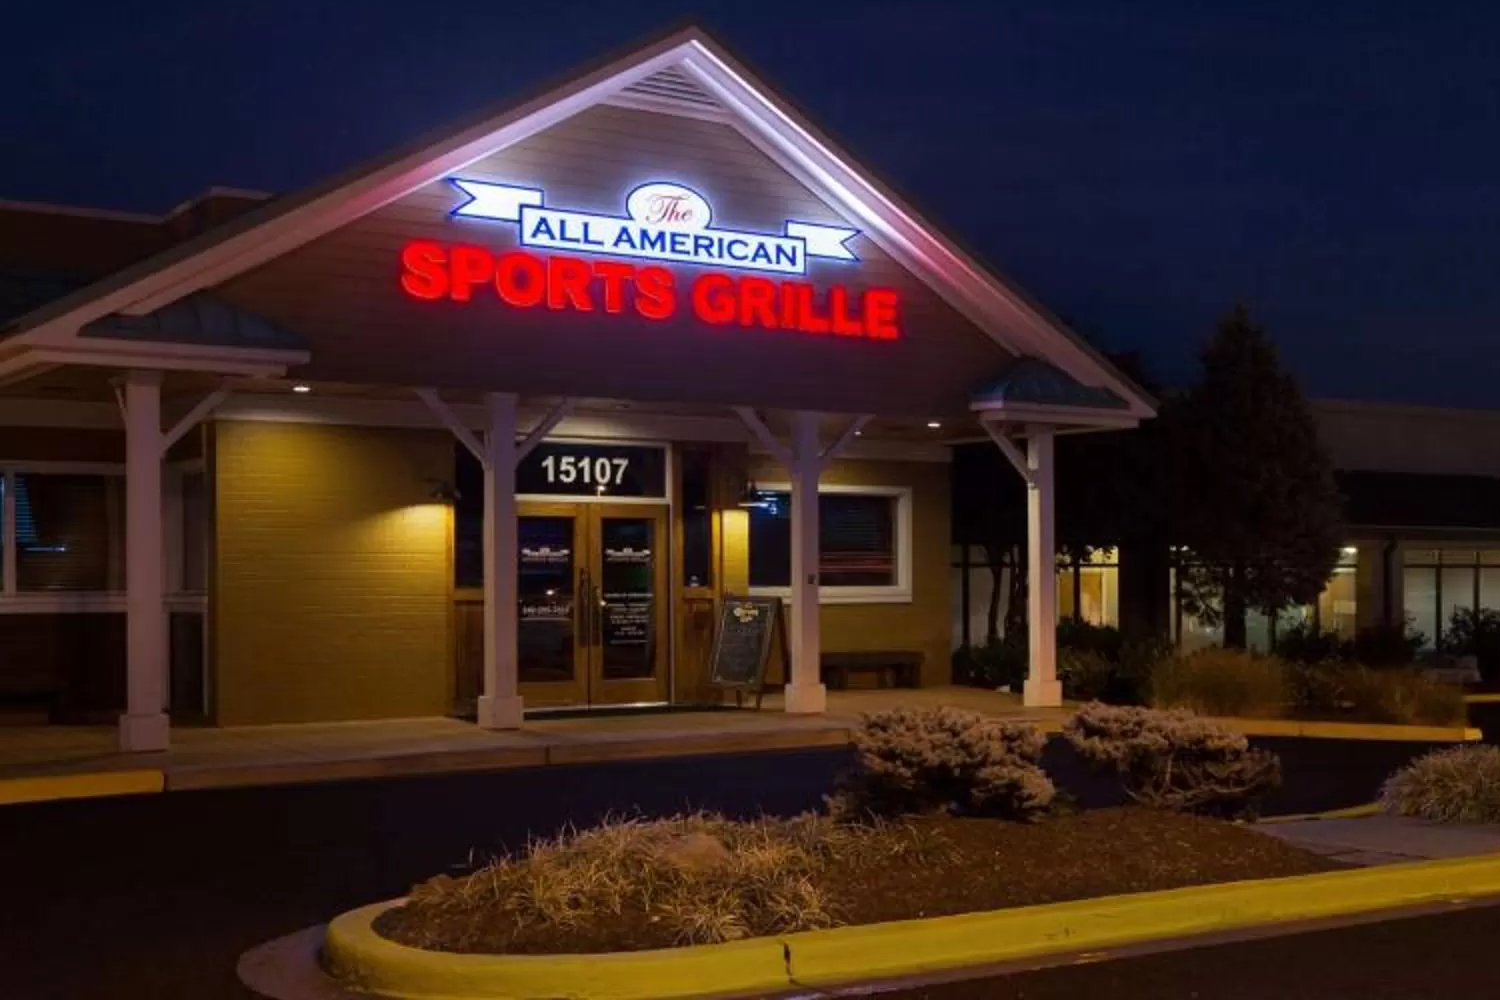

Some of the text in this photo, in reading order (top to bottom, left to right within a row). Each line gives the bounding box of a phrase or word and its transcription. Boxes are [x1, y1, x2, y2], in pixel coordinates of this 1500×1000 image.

[645, 194, 694, 224] The
[531, 217, 798, 267] ALL AMERICAN
[401, 239, 898, 340] SPORTS GRILLE
[541, 455, 629, 484] 15107
